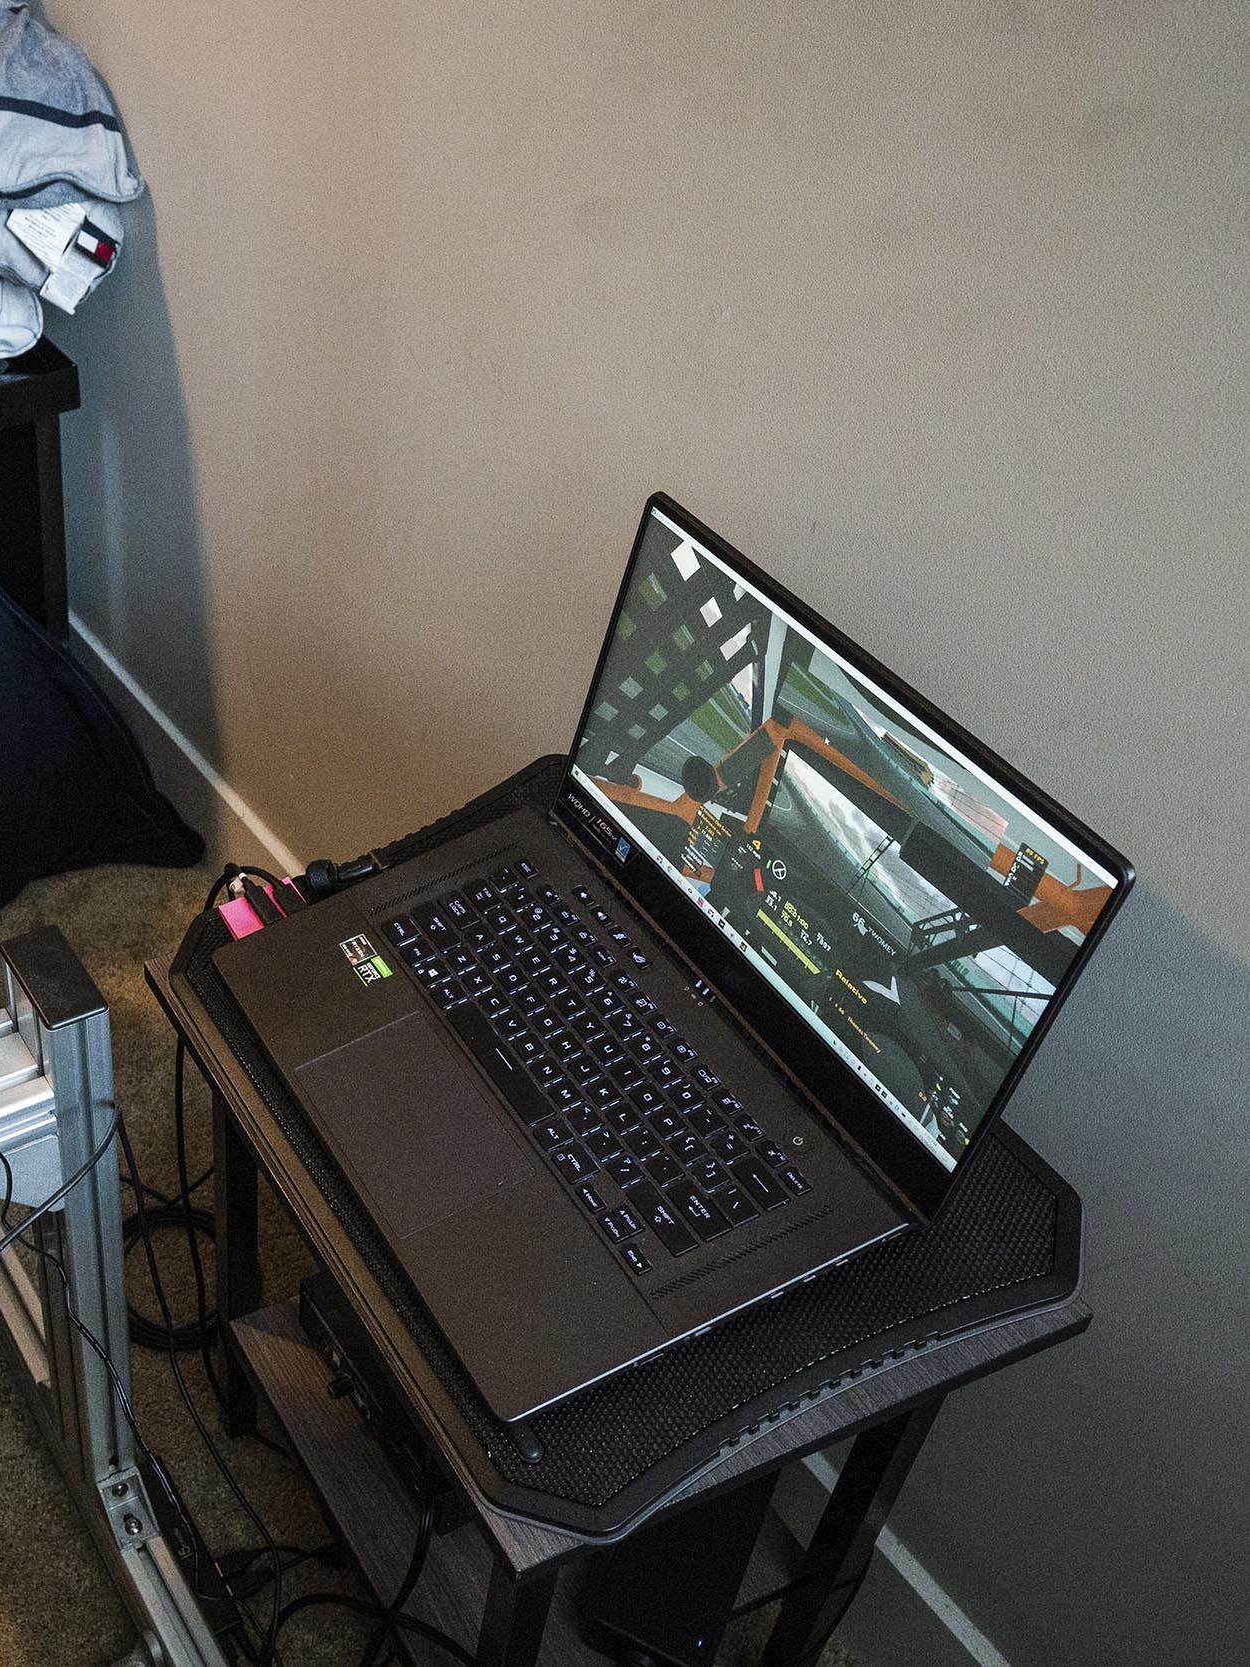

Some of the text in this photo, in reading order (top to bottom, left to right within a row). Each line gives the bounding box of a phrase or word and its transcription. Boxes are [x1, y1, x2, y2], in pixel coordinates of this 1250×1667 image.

[568, 793, 590, 817] WQHD
[752, 840, 761, 850] 4
[483, 888, 492, 898] TAB
[449, 902, 461, 916] LOCK
[454, 900, 466, 914] CAPS
[394, 922, 405, 936] CTRL
[433, 917, 446, 931] SHIFT
[515, 935, 524, 943] W
[868, 927, 896, 956] TWOMEY
[357, 964, 376, 983] RTX
[549, 978, 558, 986] R
[835, 969, 868, 1004] Relative
[444, 989, 454, 999] ALT
[544, 1018, 553, 1026] G
[525, 1043, 534, 1051] B
[562, 1041, 572, 1049] H
[604, 1045, 613, 1053] U
[641, 1043, 651, 1052] 8
[543, 1066, 552, 1074] N
[661, 1067, 671, 1075] 9
[560, 1089, 572, 1099] M
[599, 1088, 609, 1096] K
[643, 1093, 652, 1102] O
[619, 1113, 626, 1122] L
[663, 1118, 673, 1126] P
[548, 1128, 559, 1140] ALT
[567, 1154, 581, 1172] CTRL
[690, 1195, 710, 1219] ENTER
[657, 1206, 675, 1224] SHIFT
